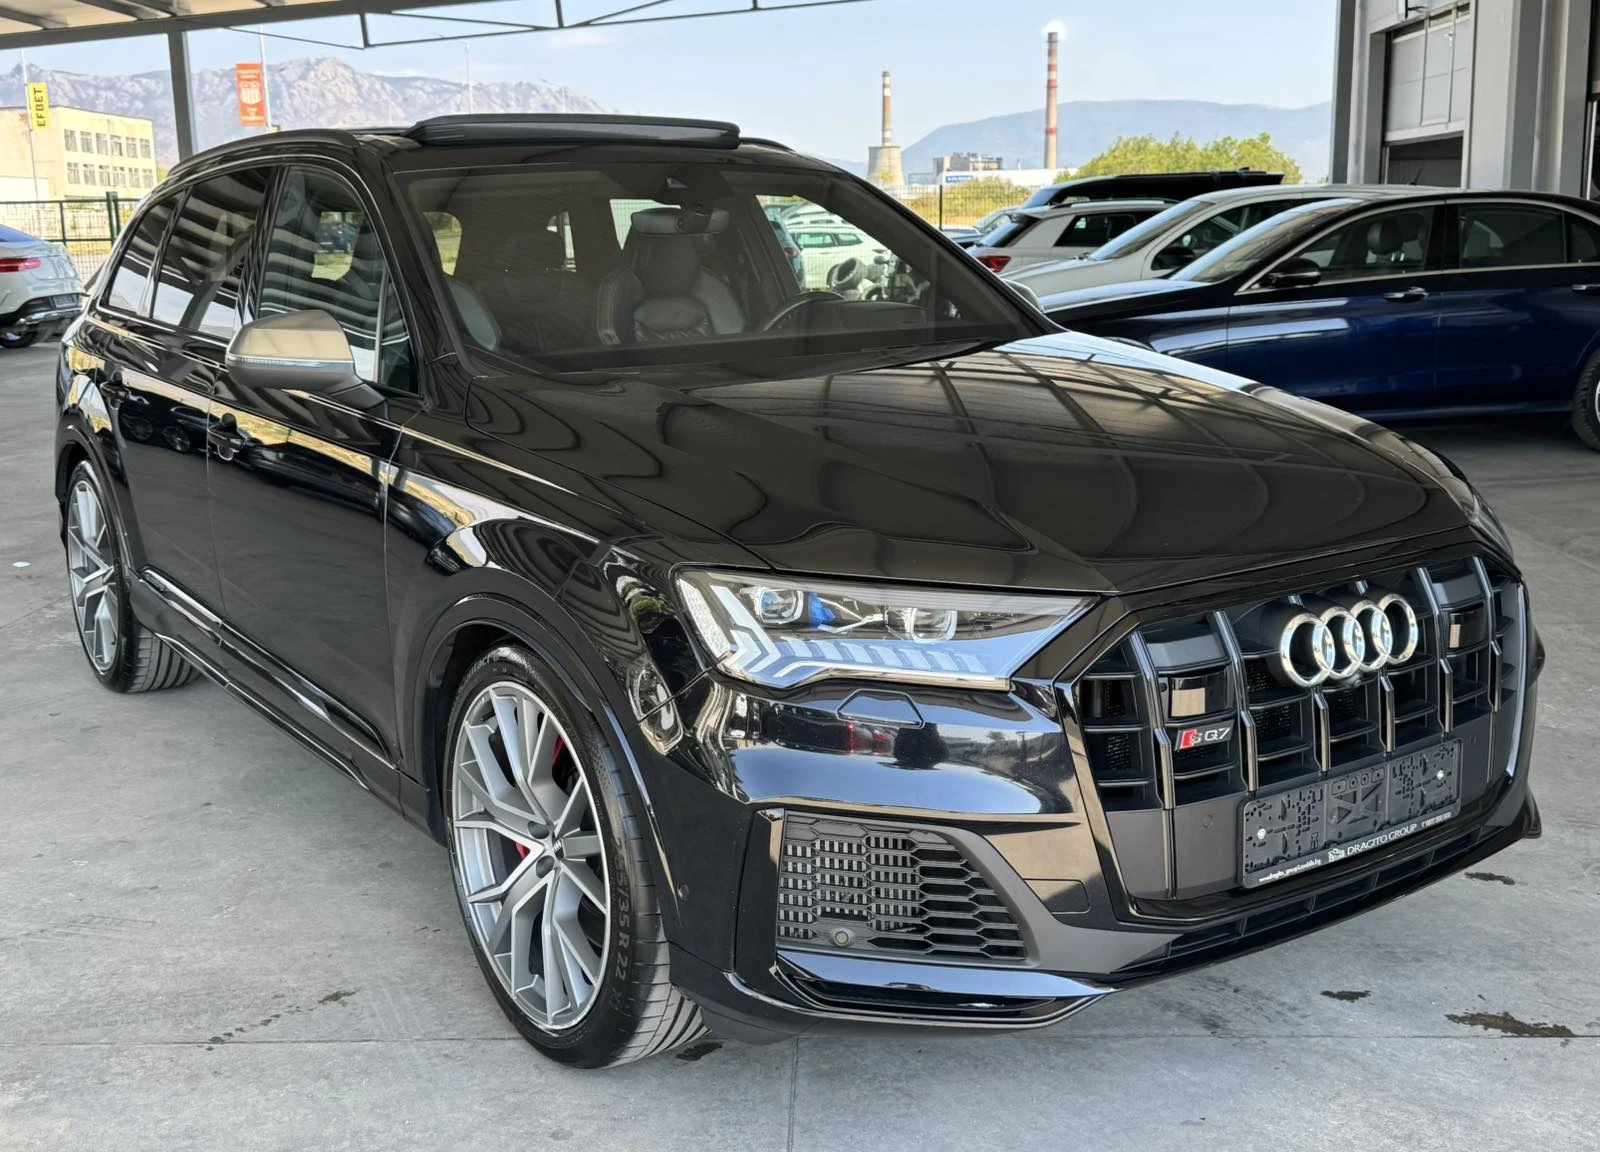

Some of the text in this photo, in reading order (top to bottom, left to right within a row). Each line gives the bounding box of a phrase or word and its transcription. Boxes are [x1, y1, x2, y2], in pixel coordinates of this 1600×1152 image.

[33, 87, 46, 127] EFBET
[1347, 833, 1388, 856] DRAGITO
[1388, 823, 1418, 842] GROUP
[618, 932, 630, 950] R
[615, 952, 629, 982] 22
